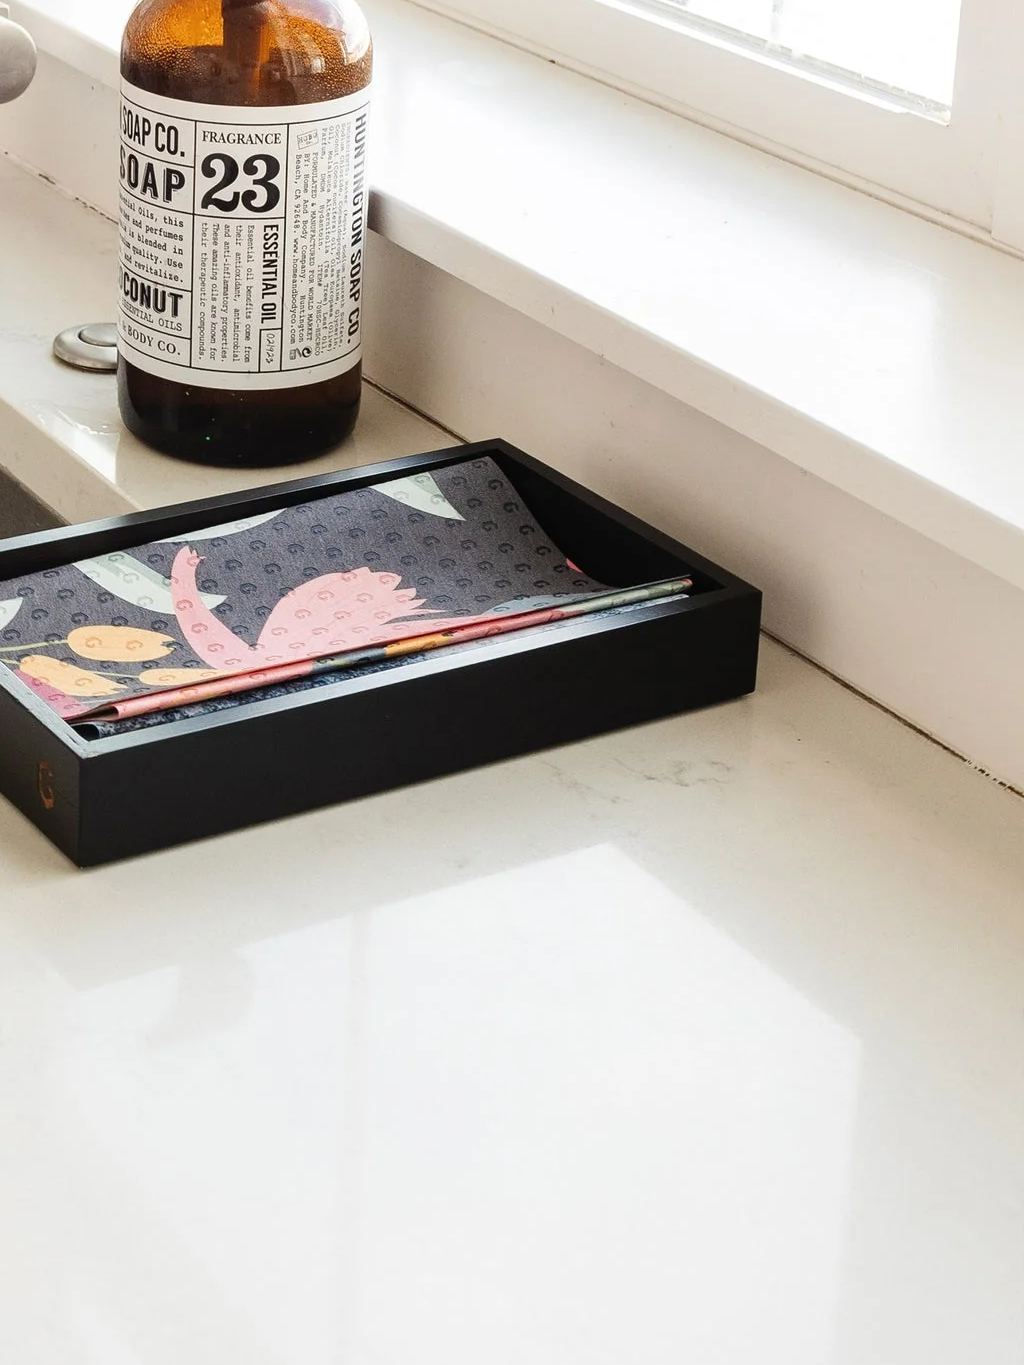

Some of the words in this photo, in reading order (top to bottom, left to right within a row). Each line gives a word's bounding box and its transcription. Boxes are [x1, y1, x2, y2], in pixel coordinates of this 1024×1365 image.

[123, 105, 151, 146] SOAP
[154, 122, 185, 157] CO.
[202, 130, 282, 145] FRAGRANCE
[119, 144, 186, 204] SOAP
[201, 152, 281, 213] 23
[351, 113, 367, 247] HUNTINGTON
[138, 206, 157, 222] Oils,
[163, 216, 183, 227] this
[145, 225, 183, 241] perfumes
[300, 220, 308, 239] Body
[138, 232, 167, 251] blended
[173, 245, 183, 255] in
[235, 225, 243, 246] their
[246, 225, 255, 263] Essential
[132, 245, 162, 264] quality.
[167, 258, 183, 269] Use
[135, 260, 184, 282] revitalize.
[246, 268, 254, 281] oil
[261, 224, 279, 299] ESSENTIAL
[350, 249, 361, 302] SOAP
[199, 253, 208, 307] therapeutic
[221, 241, 231, 314] anti-inflammatory
[233, 252, 242, 302] antioxidant,
[289, 238, 298, 344] www.homeandbodyco.com
[245, 286, 253, 319] benefits
[261, 302, 277, 324] OIL
[297, 295, 306, 343] Huntington
[128, 325, 154, 347] BODY
[157, 340, 181, 355] CO.
[158, 318, 182, 332] OILS
[198, 311, 206, 360] compounds.
[220, 317, 229, 363] properties.
[232, 308, 240, 362] antimicrobial
[348, 307, 359, 344] CO.
[209, 347, 217, 361] for
[244, 346, 252, 363] from
